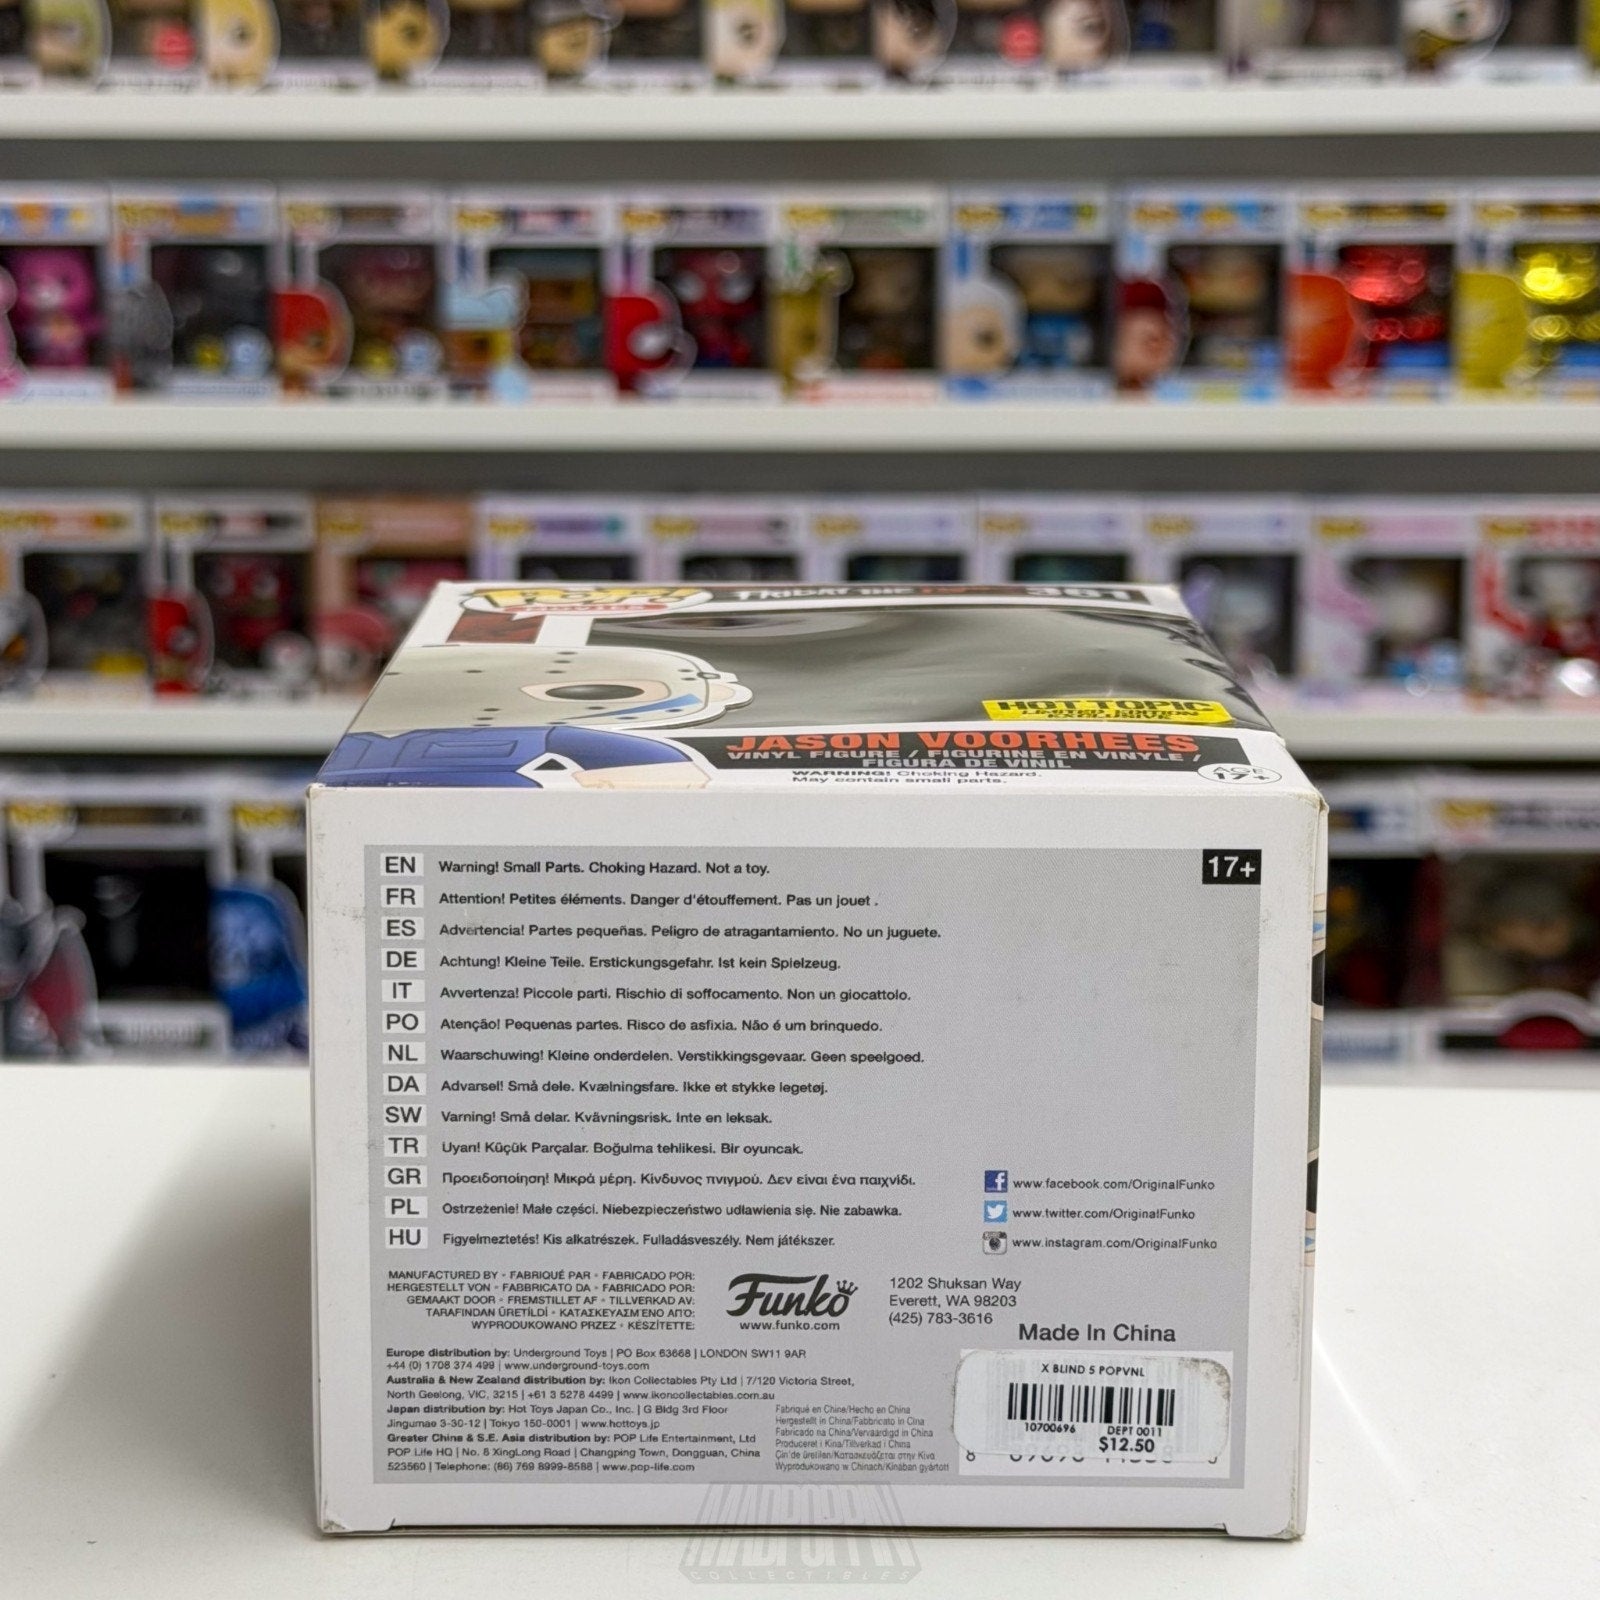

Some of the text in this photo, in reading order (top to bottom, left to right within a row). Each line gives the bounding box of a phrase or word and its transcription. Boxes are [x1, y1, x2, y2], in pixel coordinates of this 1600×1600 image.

[998, 700, 1214, 712] HOT TOPIC
[726, 731, 1200, 753] JASON VOORHEES
[728, 750, 1183, 761] VINYL FIGURE FIGURINE EN VINYLE
[862, 758, 1071, 769] FIGURA DE VINIL
[897, 770, 969, 778] Choking
[1212, 766, 1265, 775] AGE
[1212, 773, 1271, 781] 17+
[792, 777, 829, 785] May
[385, 856, 416, 874] EN
[438, 861, 770, 877] Warning! Small Parts. Choking Hazard. Not a toy.
[1208, 855, 1256, 878] 17+
[386, 888, 416, 905] FR
[438, 892, 871, 909] Attention! Petites éléments. Danger d'étouffement. Pas un jouet
[386, 919, 416, 937] ES
[439, 924, 941, 941] Advertencia! Partes pequeñas. Peligro de atragantamiento. No un juguete.
[386, 950, 417, 968] DE
[439, 955, 841, 972] Achtung! Kleine Teile. Erstickungsgefahr. Ist kein Spielzeug.
[392, 982, 412, 999] IT
[440, 987, 911, 1003] Avvertenza! Piccole parti. Rischio di soffocamento. Non un giocattolo.
[388, 1044, 418, 1062] NL
[440, 1049, 924, 1065] Waarschuwing! Kleine onderdelen. Verstikkingsgevaar. Geen speelgoed.
[385, 1106, 422, 1124] SW
[441, 1110, 772, 1125] Varning! Små delar. Kvävningsrisk. Inte en leksak.
[387, 1167, 421, 1185] GR
[442, 1172, 916, 1188] Προειδοποίηση! Μικρά μέρη. Κίνδυνος πνιγμού. Δεν είναι ένα παιχνίδι.
[1012, 1177, 1215, 1192] www.facebook.com/OriginalFunko
[1012, 1207, 1196, 1222] www.twitter.com/OriginalFunko
[389, 1228, 421, 1246] HU
[443, 1233, 835, 1248] Figyelmeztetés! Kis alkatrészek. Fulladásveszély. Nem játékszer.
[1012, 1237, 1218, 1252] www.instagram.com/OriginalFunko
[388, 1269, 695, 1281] MANUFACTURED BY FABRIQUÉ PAR FABRICADO POR:
[890, 1276, 1022, 1292] 1202 Shuksan Way
[726, 1273, 857, 1317] Funko
[889, 1294, 1017, 1308] Everett, WA 98203
[739, 1319, 840, 1331] www.funko.com
[888, 1311, 994, 1327] (425) 783-3616
[1019, 1323, 1176, 1342] Made In China
[1041, 1363, 1145, 1377] X BLIND 5 POPVNL
[1024, 1422, 1076, 1434] 10700696
[1107, 1424, 1163, 1437] DEPT 0011
[1098, 1435, 1155, 1454] $12.50
